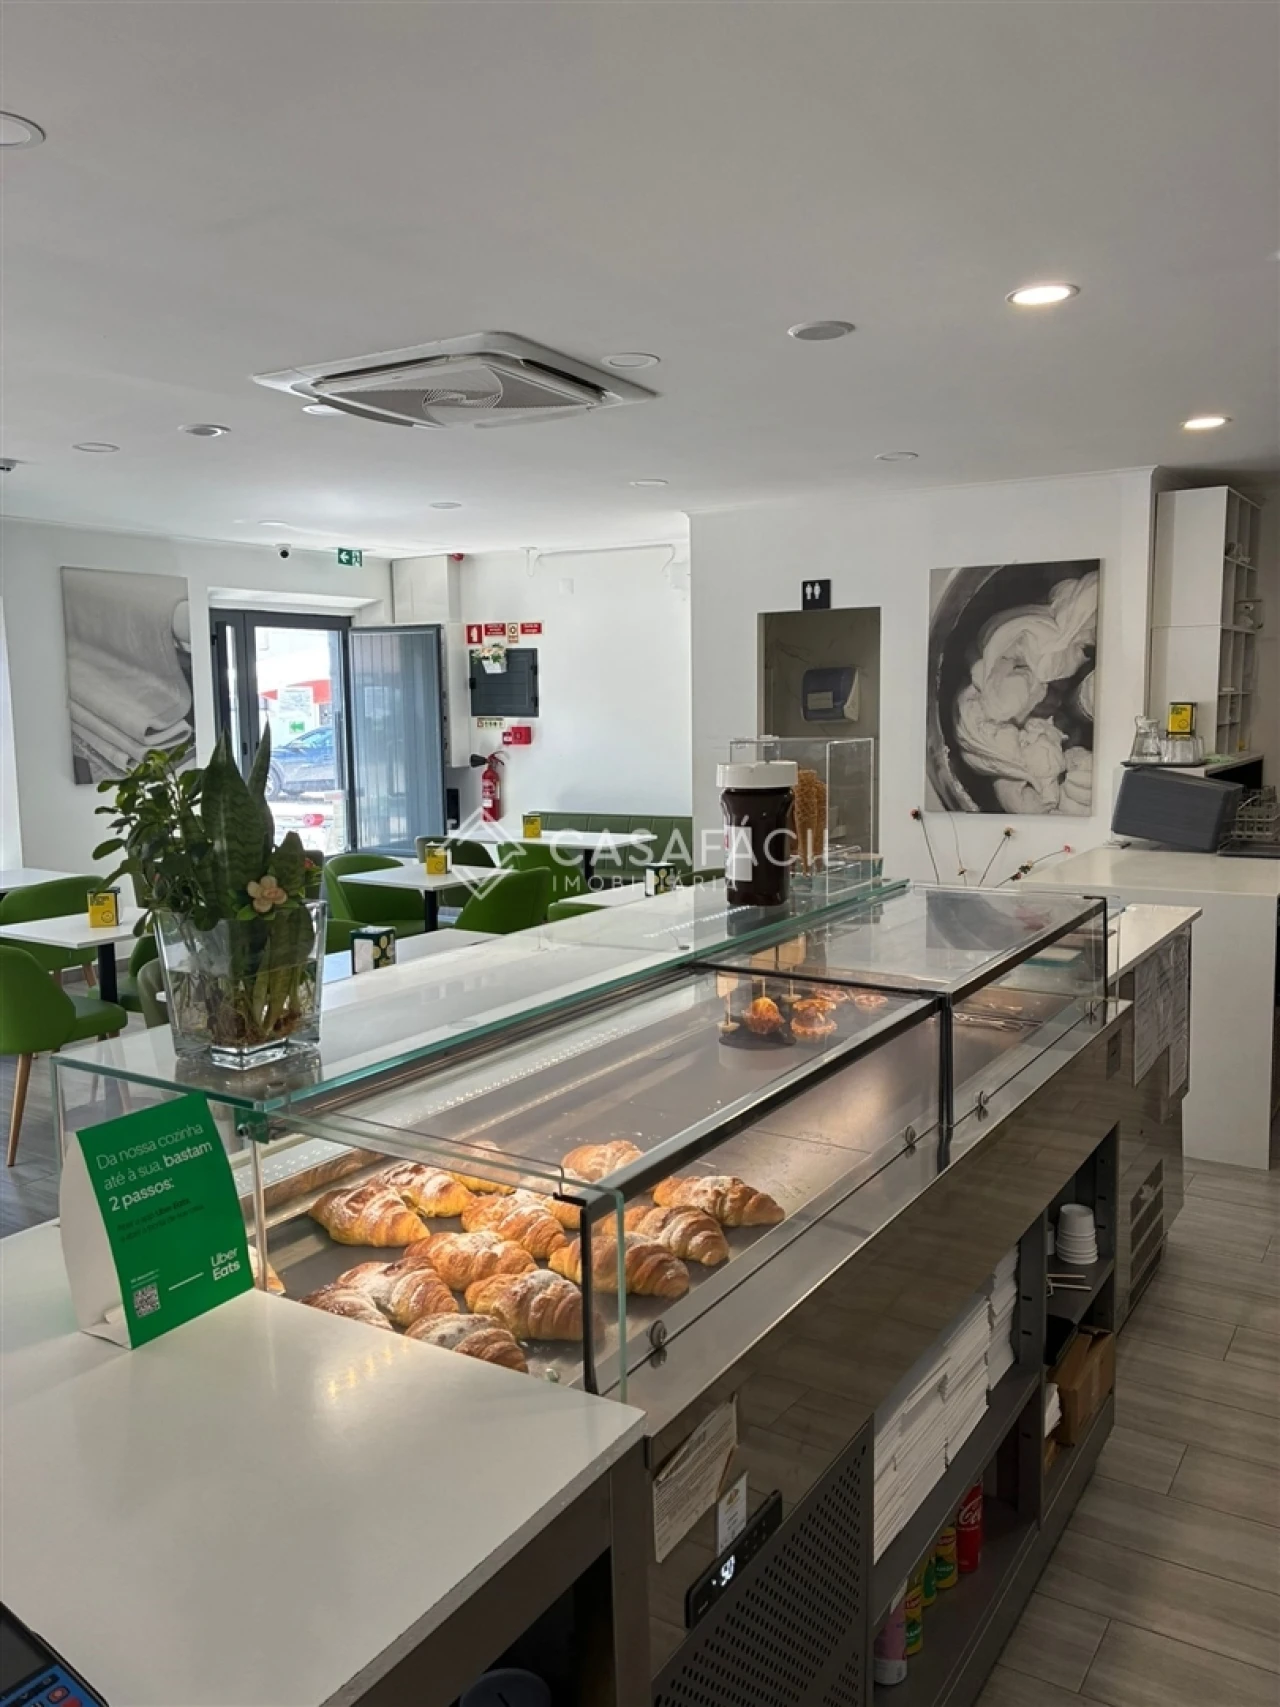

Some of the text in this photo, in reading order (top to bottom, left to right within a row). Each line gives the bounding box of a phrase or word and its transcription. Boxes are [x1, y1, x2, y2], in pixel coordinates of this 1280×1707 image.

[96, 1122, 204, 1170] Da nossa cozinha
[104, 1171, 126, 1191] até
[127, 1167, 138, 1182] à
[162, 1141, 213, 1168] bastam
[108, 1177, 175, 1212] 2 passos:
[210, 1247, 238, 1268] Uber
[212, 1259, 241, 1282] Eats
